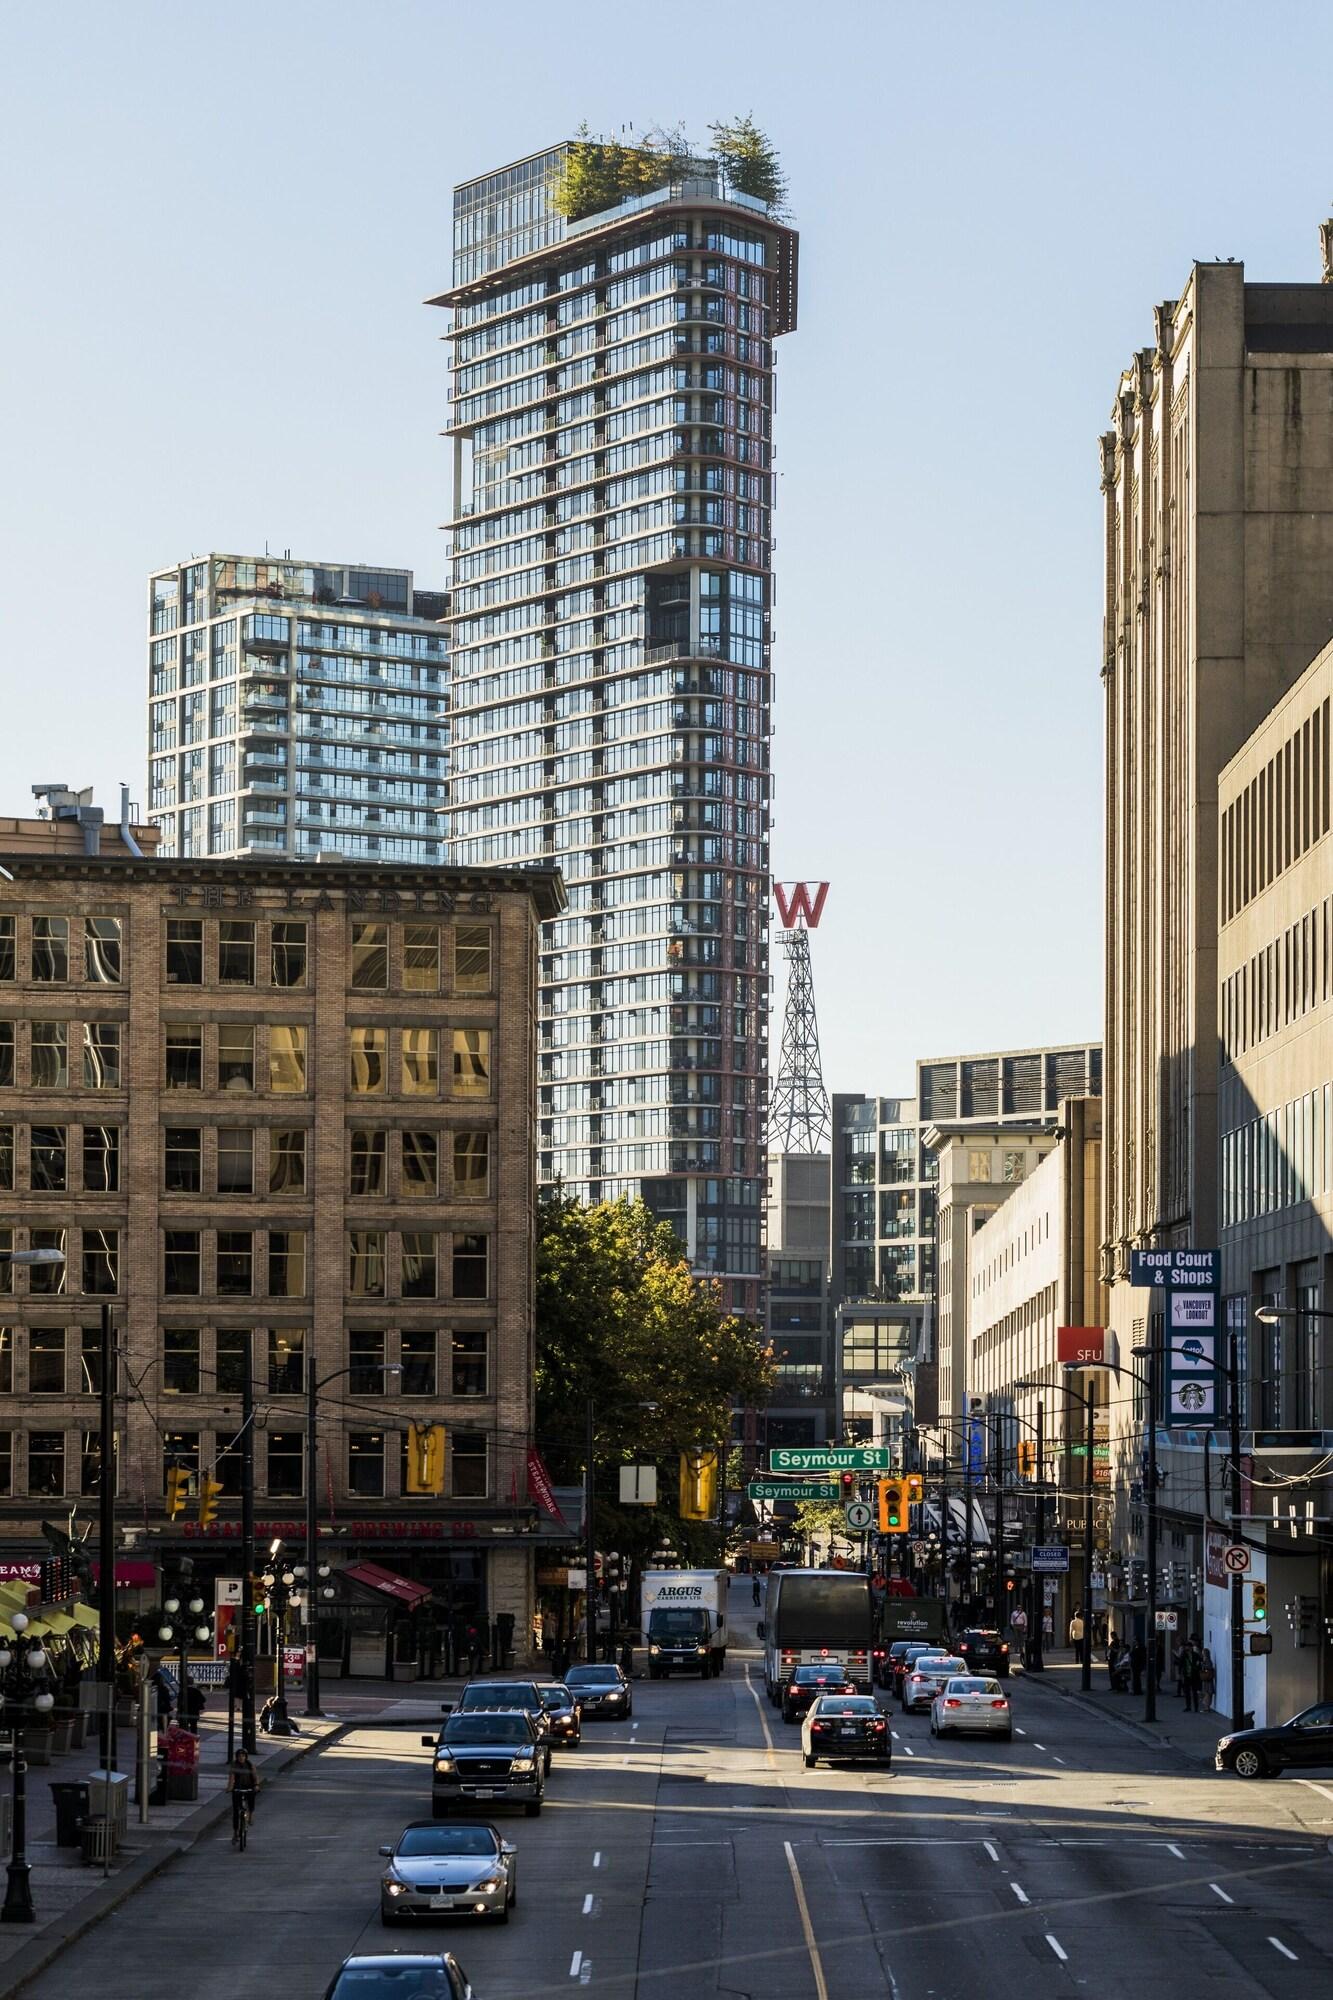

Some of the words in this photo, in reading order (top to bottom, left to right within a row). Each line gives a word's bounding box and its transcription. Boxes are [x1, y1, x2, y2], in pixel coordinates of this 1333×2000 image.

[175, 884, 255, 907] THE
[283, 886, 494, 914] LANDING
[774, 882, 830, 928] W
[1139, 1251, 1172, 1267] Food
[1176, 1251, 1213, 1267] Court
[1154, 1269, 1164, 1284] &
[1171, 1268, 1213, 1286] Shops
[1183, 1300, 1211, 1310] VANCOUVER
[1186, 1310, 1208, 1320] LOOKOUT
[1077, 1349, 1103, 1361] SFU
[778, 1451, 855, 1468] Seymour
[862, 1450, 882, 1465] St
[755, 1485, 814, 1498] Seymour
[819, 1485, 834, 1497] St
[183, 1521, 321, 1538] STEAWORKS
[1066, 1519, 1105, 1529] PUBIC
[658, 1586, 702, 1596] ARGUS
